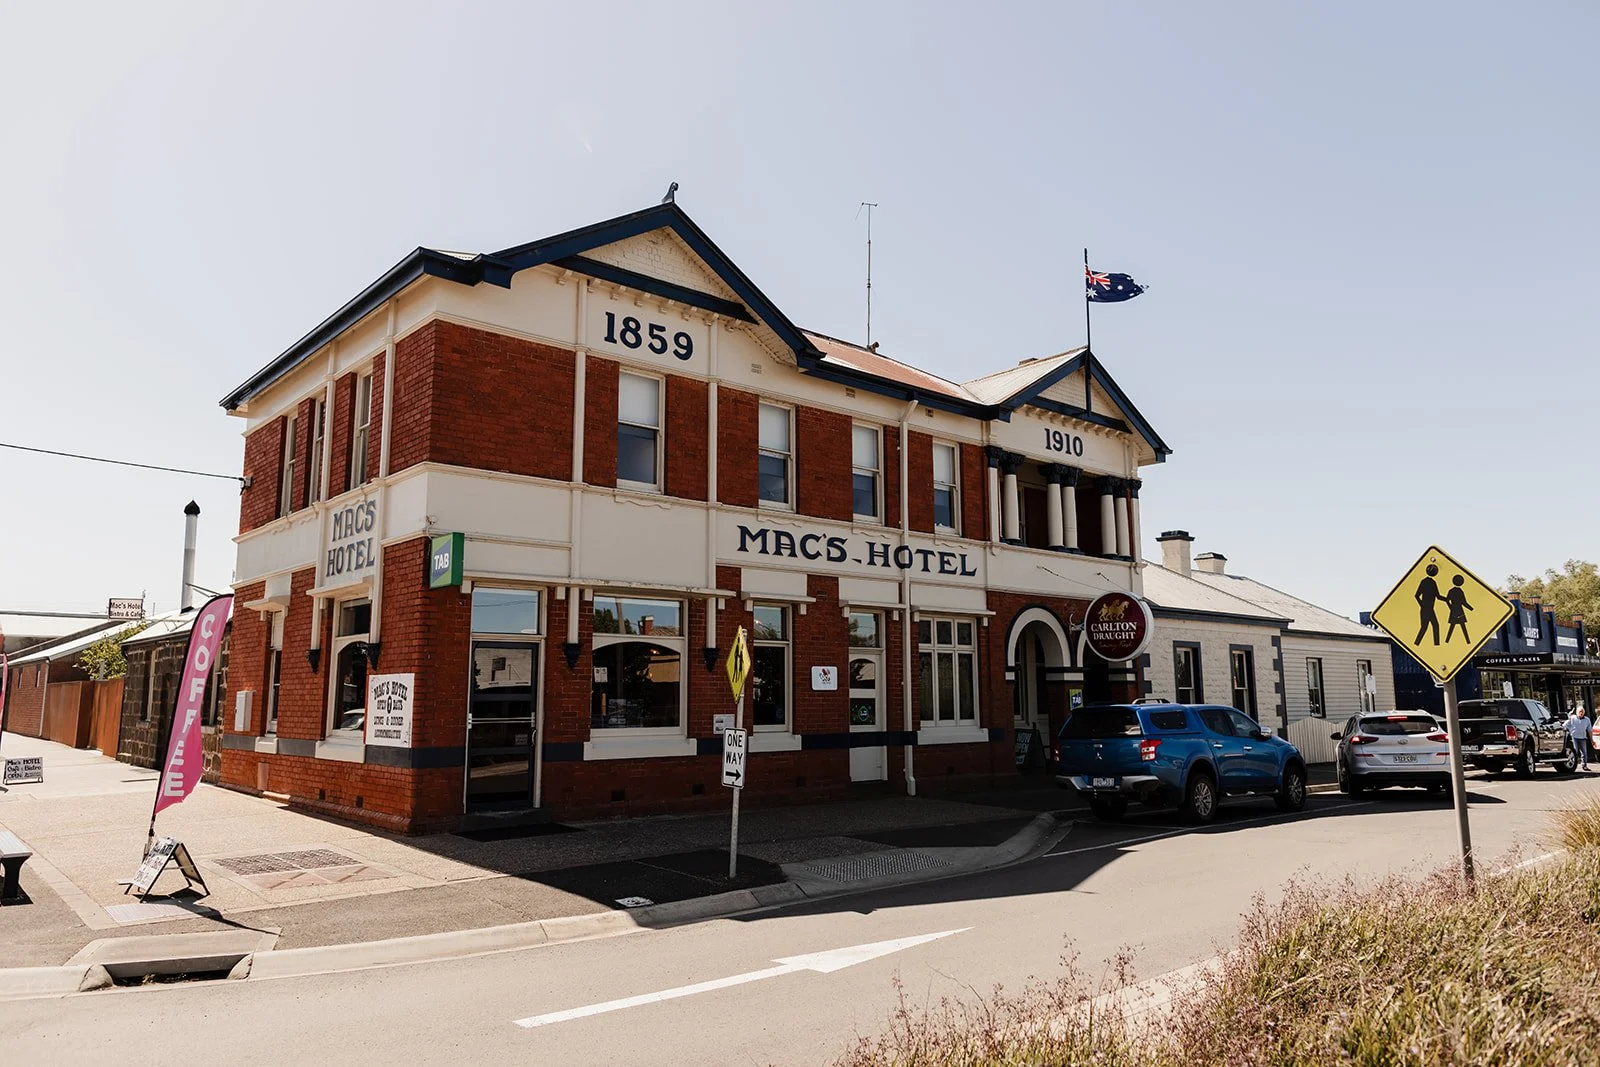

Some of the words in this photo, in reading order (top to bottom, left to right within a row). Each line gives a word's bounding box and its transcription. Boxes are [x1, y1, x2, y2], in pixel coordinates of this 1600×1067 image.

[604, 311, 694, 361] 1859
[1044, 427, 1084, 457] 1910
[326, 538, 376, 577] HOTEL
[434, 553, 450, 571] TAB
[866, 541, 978, 577] HOTEL
[1091, 621, 1138, 632] CARLTON
[1093, 631, 1136, 640] DRAUGHT
[163, 613, 216, 797] COFFEE
[727, 734, 743, 748] ONE
[726, 752, 743, 765] WAY
